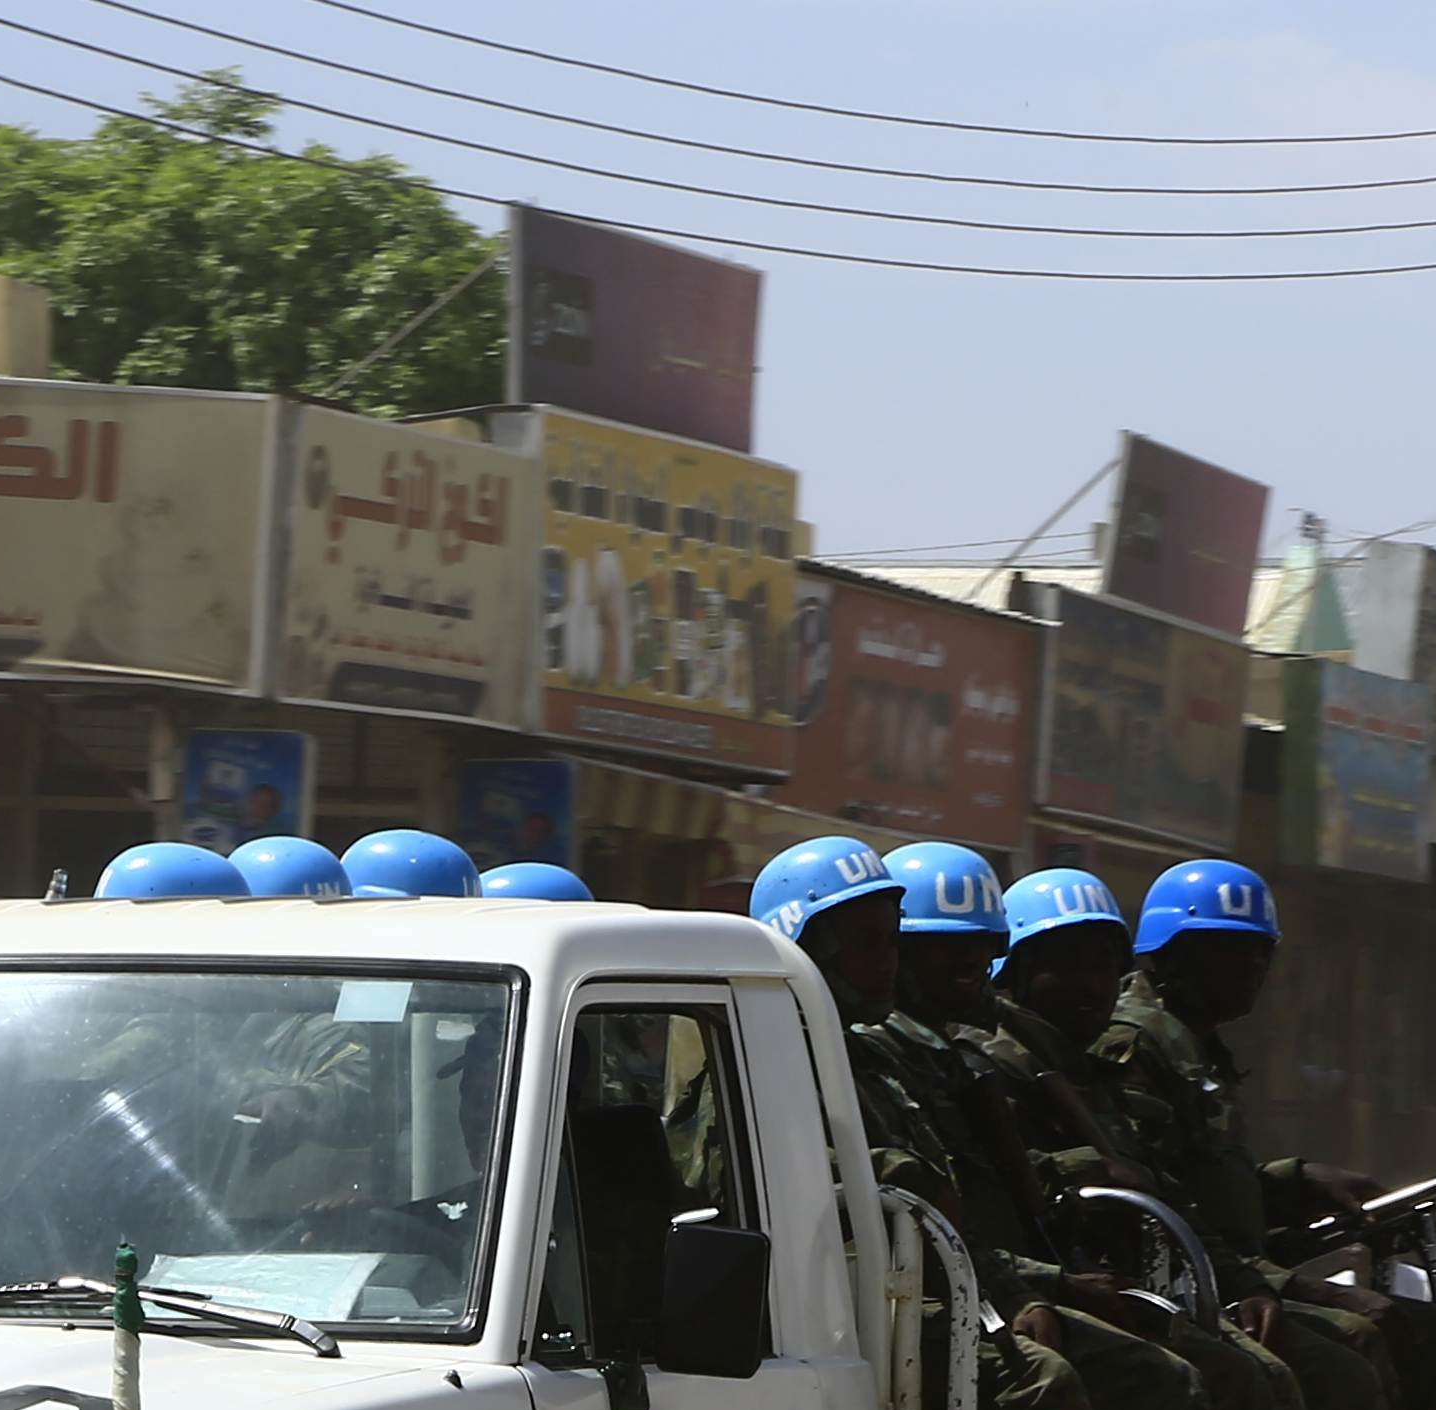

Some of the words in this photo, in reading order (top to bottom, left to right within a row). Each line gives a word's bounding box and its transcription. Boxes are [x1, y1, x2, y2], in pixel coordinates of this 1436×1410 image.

[834, 850, 885, 884] UN
[935, 870, 1003, 913] UN
[1053, 884, 1116, 916] UN
